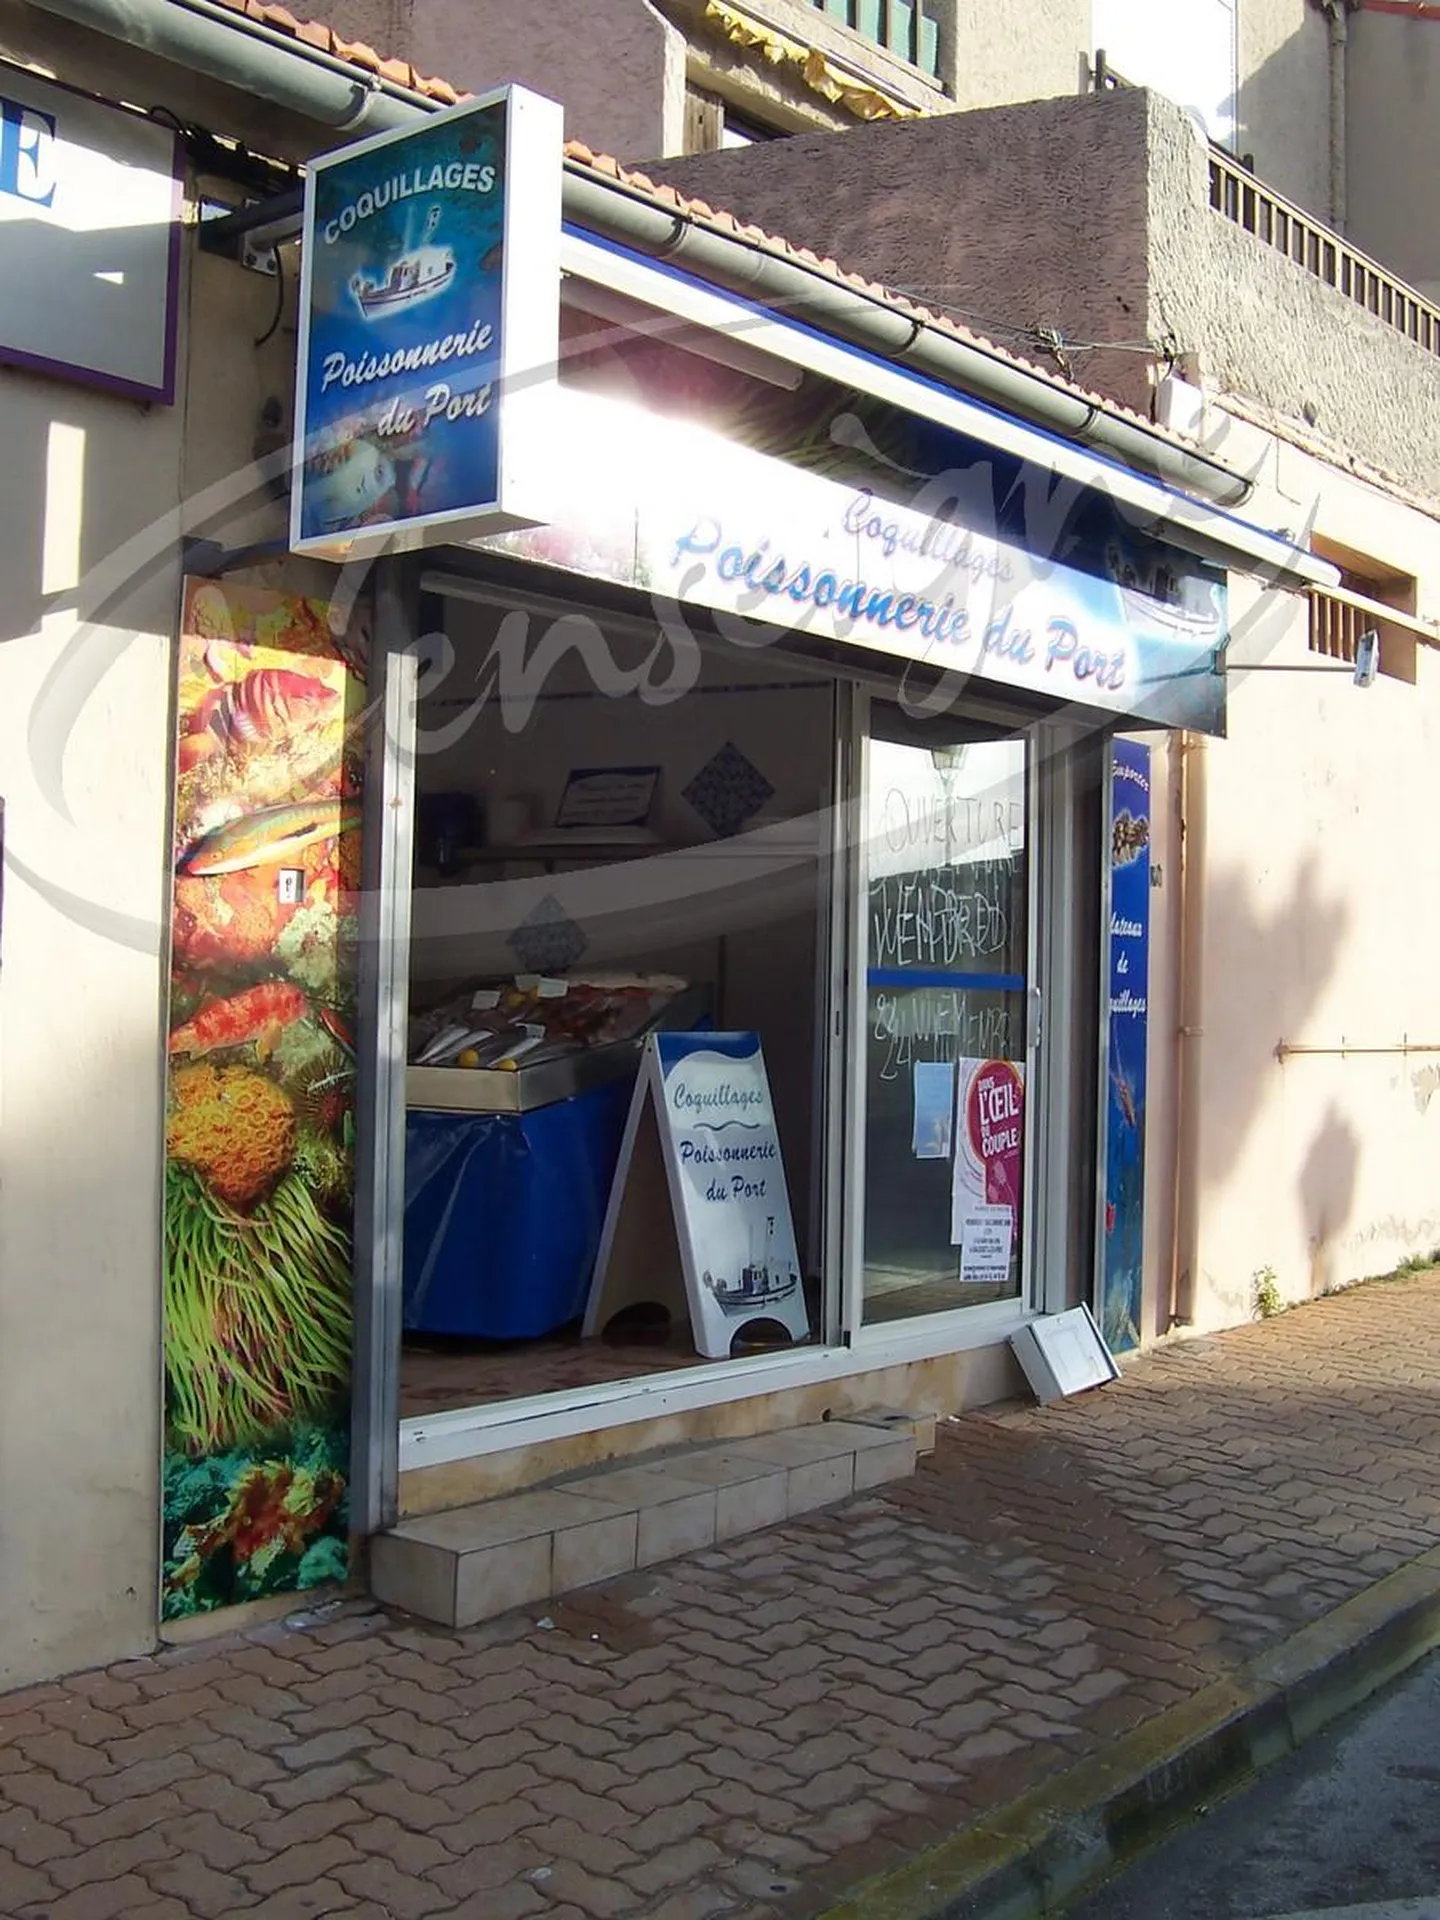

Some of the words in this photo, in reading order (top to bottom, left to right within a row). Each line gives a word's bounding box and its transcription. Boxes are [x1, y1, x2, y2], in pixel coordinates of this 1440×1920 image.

[323, 162, 496, 245] COQUILLAGES
[321, 319, 493, 394] Poissonnerie
[377, 397, 417, 437] du
[423, 382, 494, 427] Port
[841, 487, 1014, 586] Coquillages
[669, 515, 972, 646] Poissonnerie
[984, 604, 1033, 667] du
[1044, 615, 1127, 693] Port
[884, 787, 1022, 853] OUVERTURE
[673, 1082, 763, 1114] Coquillages
[680, 1139, 777, 1166] Poissonnerie
[982, 1127, 1018, 1158] COUPLE
[705, 1177, 728, 1201] du
[731, 1174, 768, 1199] Port
